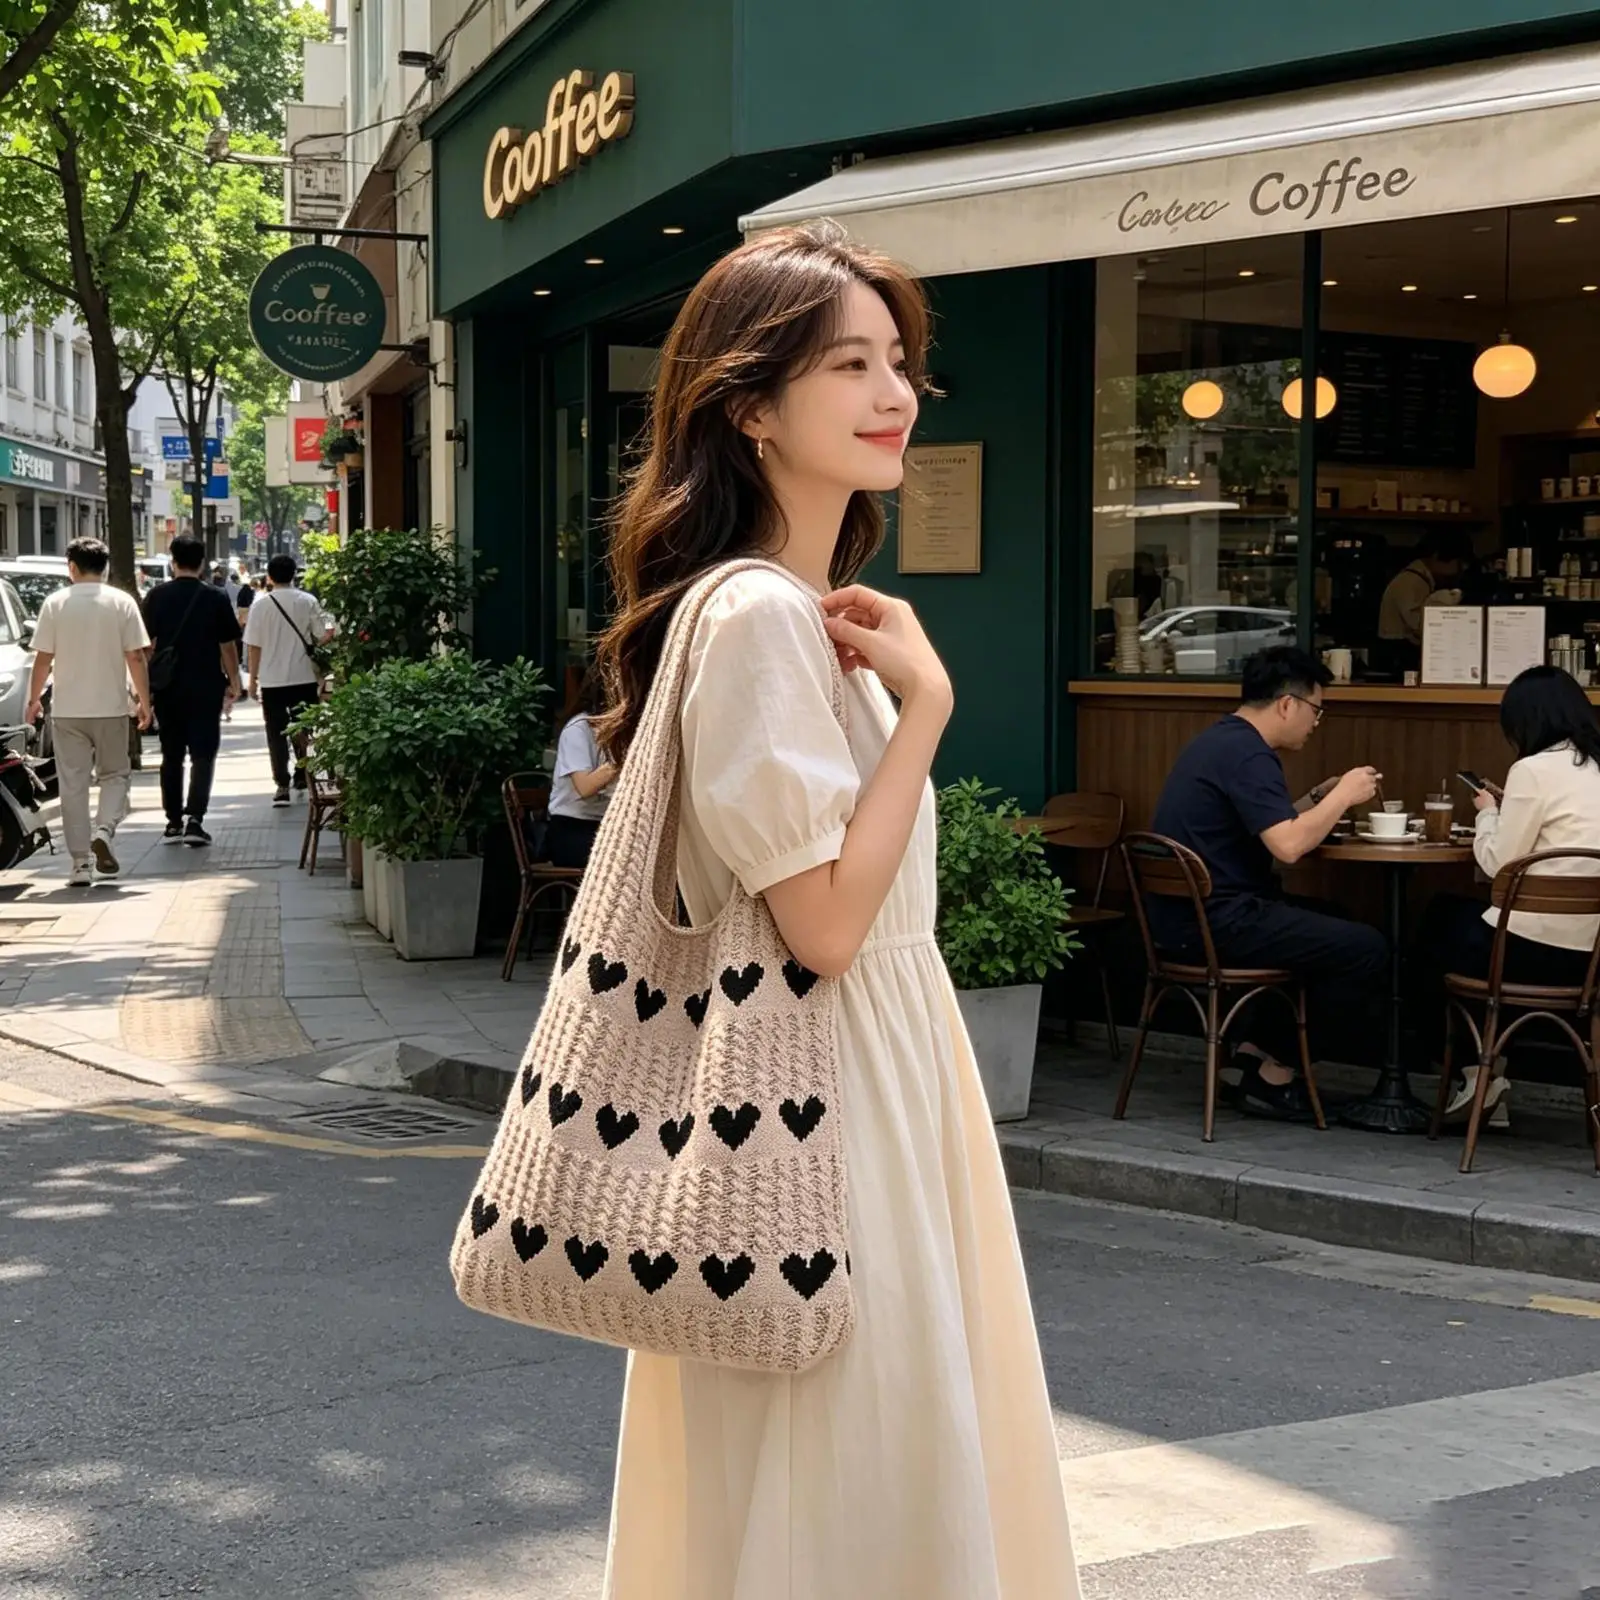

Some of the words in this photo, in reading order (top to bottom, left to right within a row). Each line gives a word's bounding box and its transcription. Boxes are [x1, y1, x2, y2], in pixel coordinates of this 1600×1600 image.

[484, 69, 633, 219] Cooffee
[1250, 157, 1416, 219] Coffee
[264, 300, 369, 326] Cooffee
